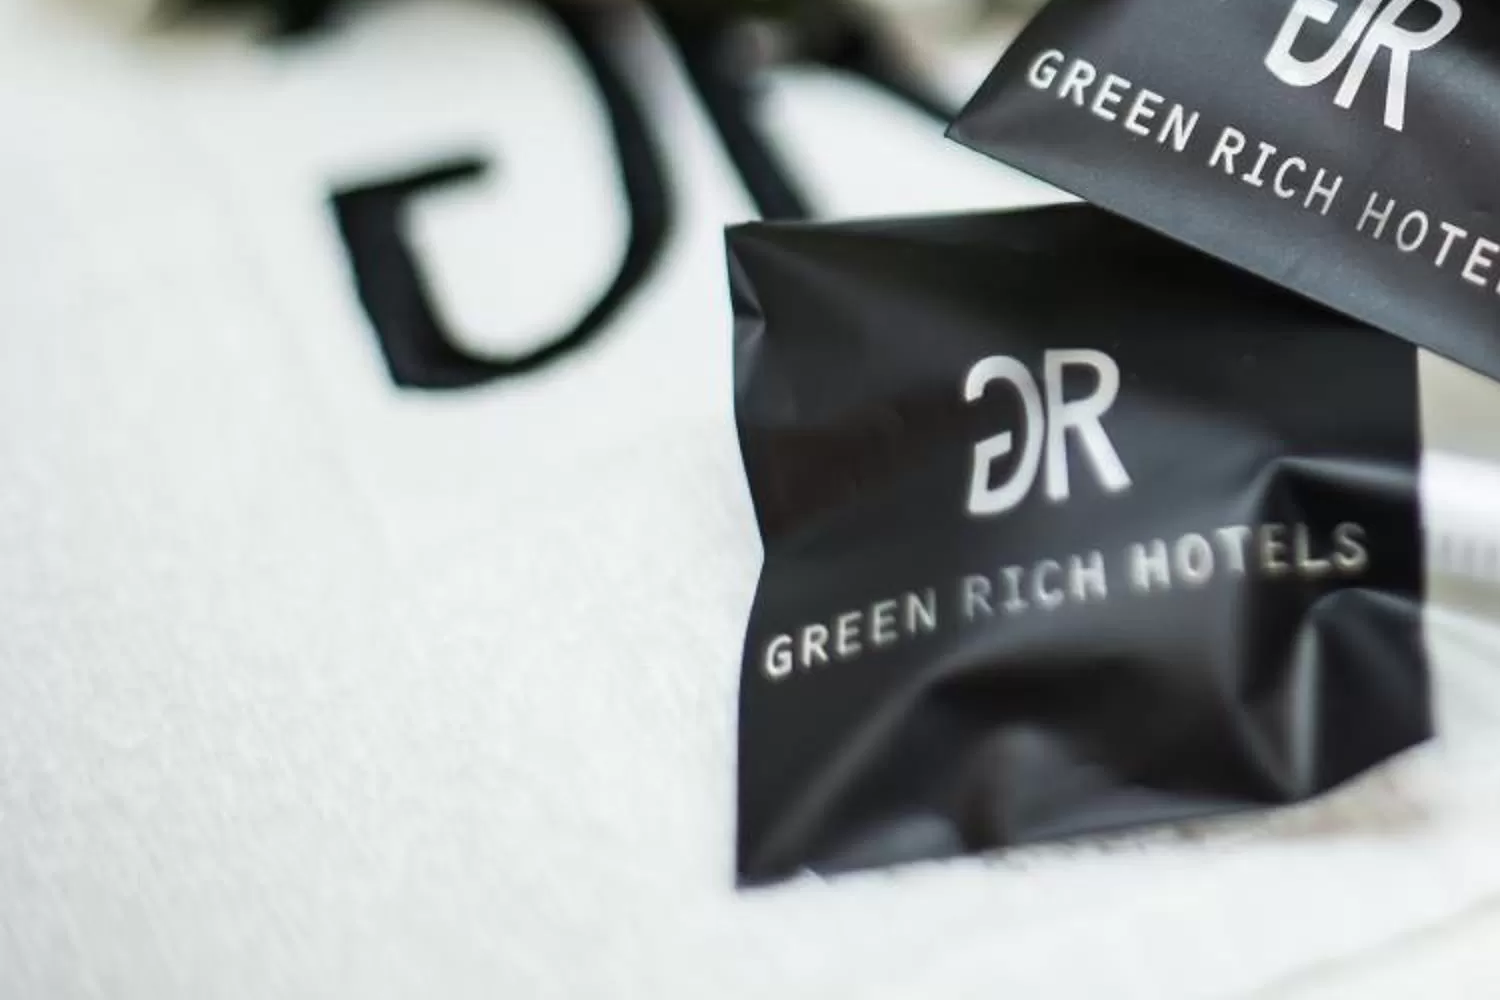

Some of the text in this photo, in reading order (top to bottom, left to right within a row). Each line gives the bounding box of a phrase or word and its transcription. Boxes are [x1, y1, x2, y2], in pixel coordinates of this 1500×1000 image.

[1025, 48, 1200, 153] GREEN
[1208, 125, 1344, 216] RICH
[763, 521, 1370, 679] GREEN RICH HOTELS
